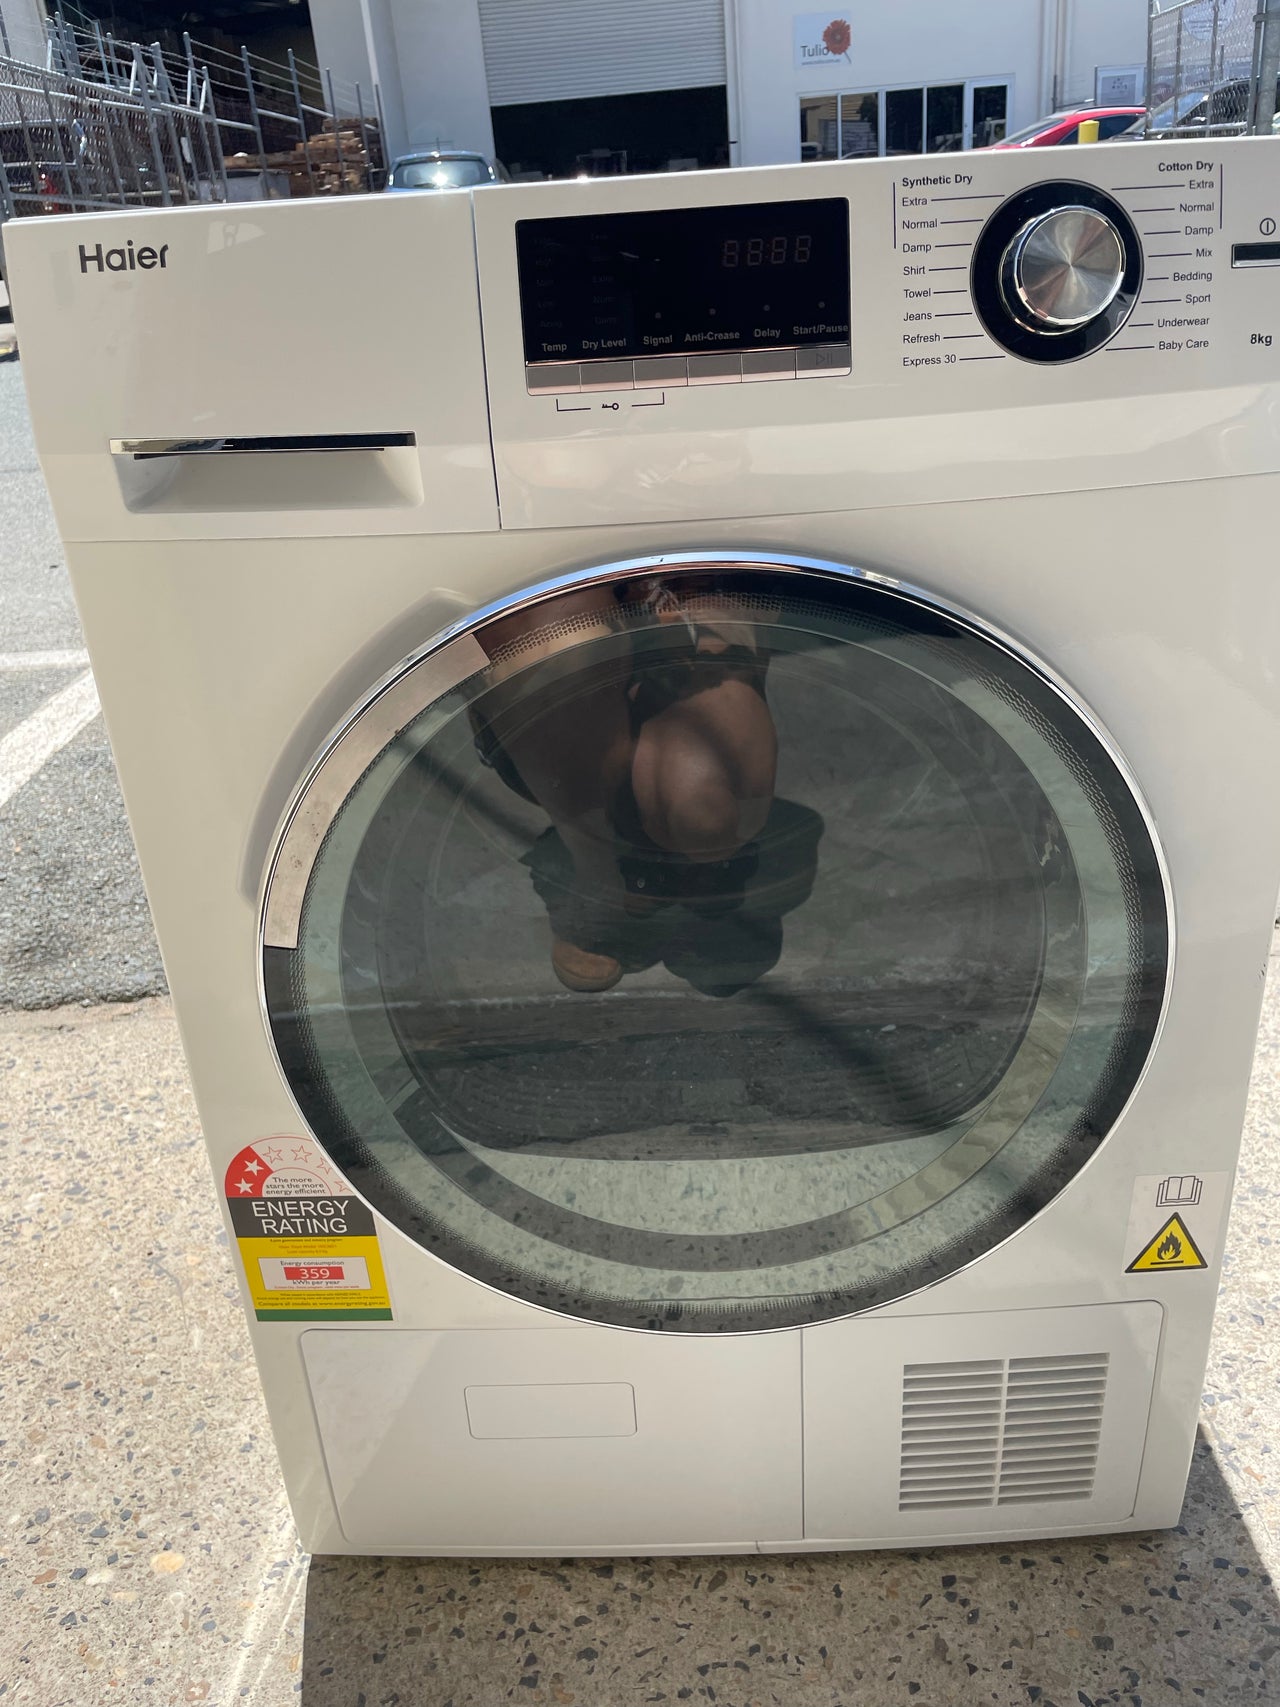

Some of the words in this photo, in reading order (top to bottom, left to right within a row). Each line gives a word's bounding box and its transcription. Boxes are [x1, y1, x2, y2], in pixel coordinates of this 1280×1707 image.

[800, 45, 829, 57] Tulio
[1158, 162, 1193, 172] Cotton
[1196, 161, 1214, 172] Dry
[902, 176, 952, 188] Synthetic
[954, 174, 973, 186] Dry
[1189, 179, 1214, 189] Extra
[902, 197, 928, 206] Extra
[1179, 202, 1214, 212] Normal
[902, 219, 938, 229] Normal
[1185, 225, 1213, 237] Damp
[902, 242, 932, 253] Damp
[1196, 248, 1212, 258] Mix
[78, 240, 169, 273] Haier
[903, 265, 926, 275] Shirt
[1173, 271, 1212, 282] Bedding
[903, 288, 931, 298] Towel
[1185, 294, 1211, 305] Sport
[903, 311, 932, 321] Jeans
[1158, 316, 1210, 328] Underwear
[754, 327, 781, 338] Delay
[793, 322, 848, 336] Start/Pause
[643, 334, 673, 346] Signal
[684, 330, 740, 342] Anti-Crease
[903, 333, 941, 344] Refresh
[1250, 333, 1272, 347] 8kg
[542, 342, 567, 353] Temp
[582, 340, 598, 350] Dry
[600, 337, 626, 348] Level
[1158, 340, 1183, 351] Baby
[1186, 338, 1209, 349] Care
[902, 355, 944, 367] Express
[946, 354, 957, 364] 30
[252, 1200, 349, 1217] ENERGY
[261, 1218, 348, 1234] RATING
[300, 1269, 330, 1279] 359
